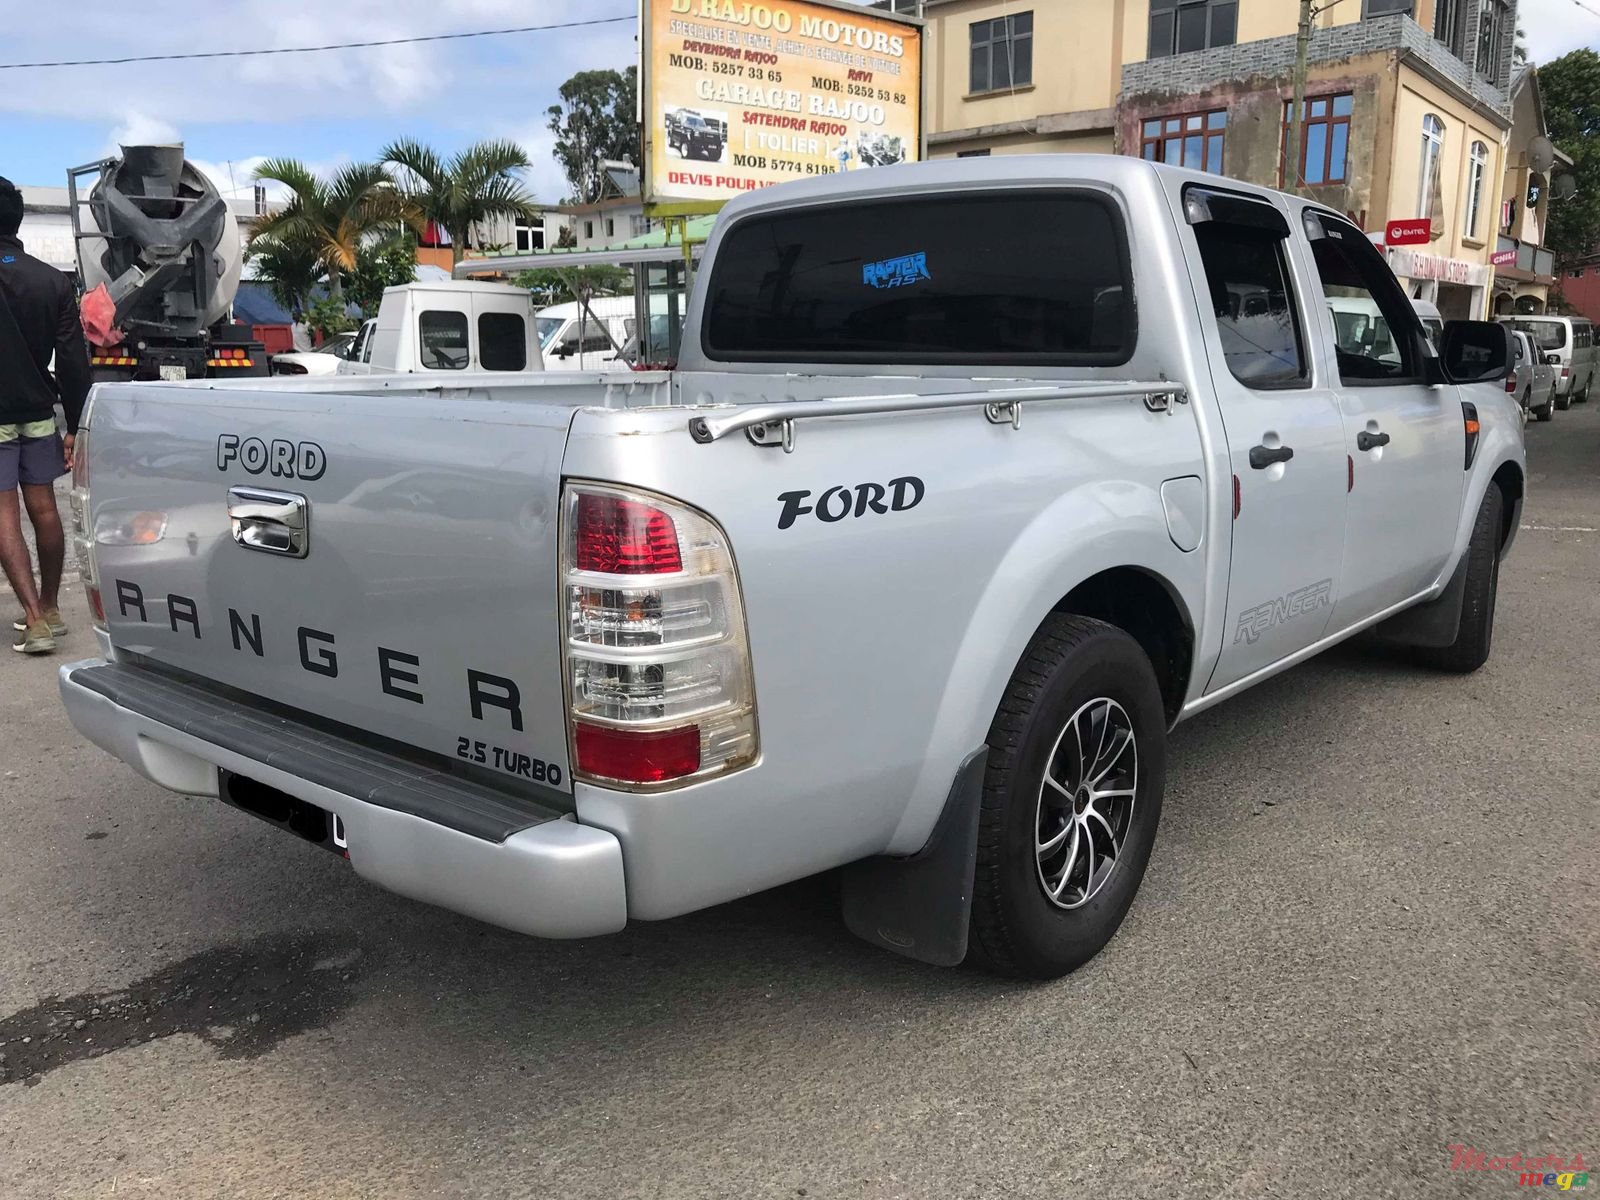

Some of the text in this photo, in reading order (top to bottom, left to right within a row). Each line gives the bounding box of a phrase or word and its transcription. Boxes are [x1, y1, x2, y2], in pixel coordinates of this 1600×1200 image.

[728, 30, 740, 44] EN
[743, 32, 772, 49] VENTE
[817, 46, 854, 66] ECHANGE
[855, 53, 866, 68] DE
[799, 14, 905, 58] MOTORS
[683, 40, 779, 66] DEVENDRA RAJOO
[669, 54, 783, 83] MOB: 5257 33 65
[848, 68, 874, 83] RAVI
[695, 79, 886, 126] GARAGE RAJOO
[812, 76, 907, 105] MOB: 5252 53 82
[742, 111, 848, 137] SATENDRA RAJOO
[759, 130, 822, 156] TOLIER
[733, 154, 836, 175] MOB 5774 8195
[668, 171, 713, 187] DEVIS
[715, 175, 756, 191] POUR
[1402, 228, 1426, 236] EMTEL
[1448, 261, 1469, 283] STORE
[1493, 251, 1516, 264] CHILI
[217, 434, 327, 480] FORD
[777, 476, 925, 530] FORD
[1233, 578, 1332, 645] RANGER
[116, 579, 524, 732] RANGER
[456, 736, 562, 786] 2.5 TURBO
